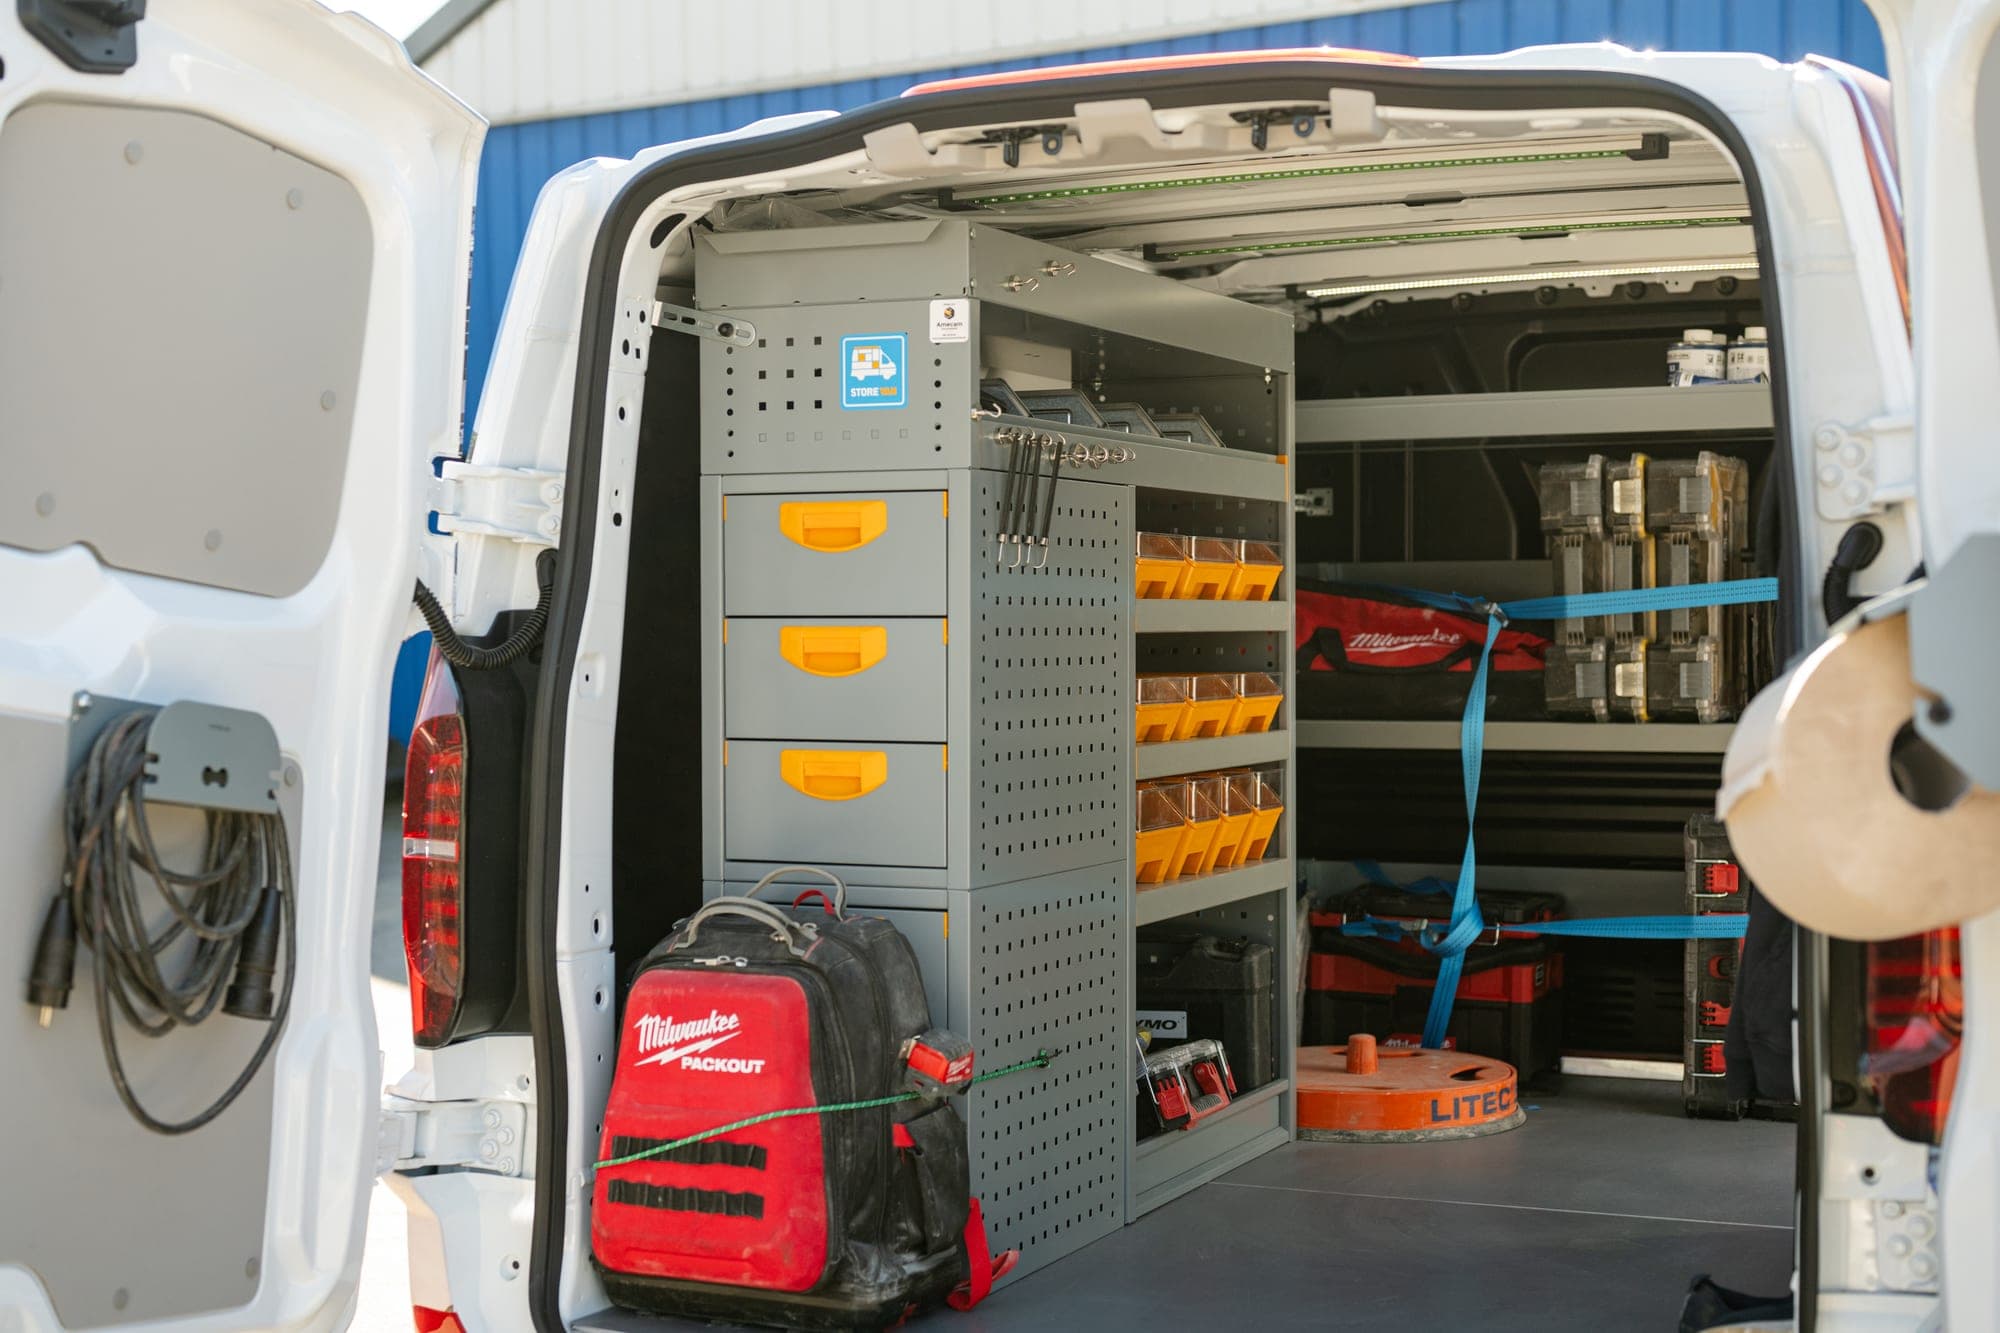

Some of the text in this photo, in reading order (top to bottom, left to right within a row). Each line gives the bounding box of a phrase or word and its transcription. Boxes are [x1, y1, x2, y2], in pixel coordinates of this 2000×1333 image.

[851, 387, 879, 397] STORE
[1349, 627, 1461, 647] Milwaukee
[633, 1009, 741, 1054] Milwaukee
[681, 1056, 766, 1074] PACKOUT
